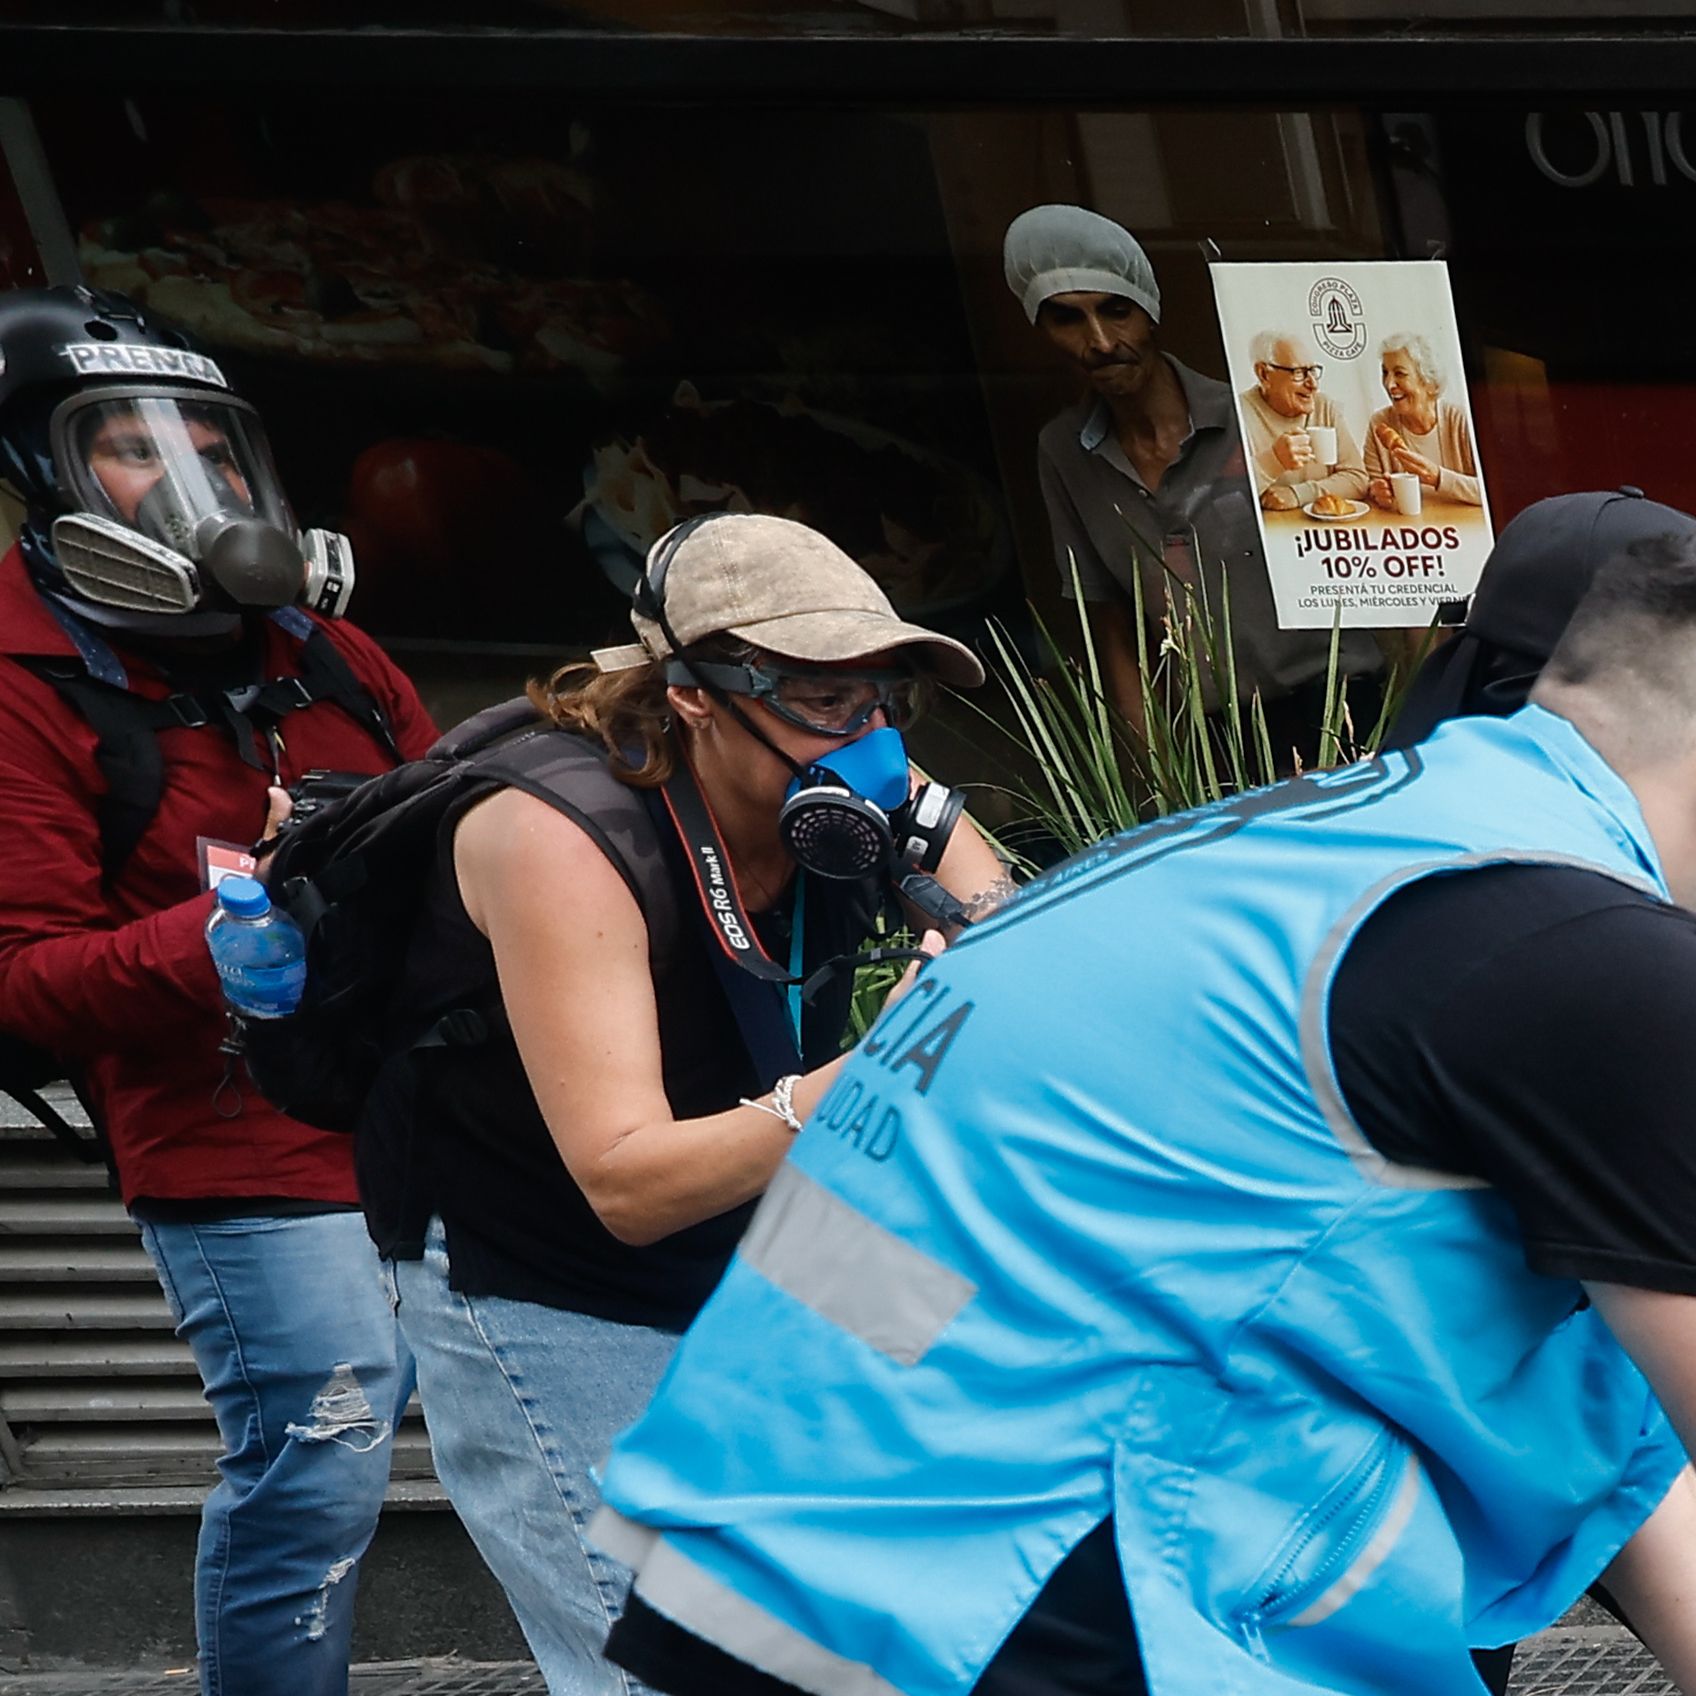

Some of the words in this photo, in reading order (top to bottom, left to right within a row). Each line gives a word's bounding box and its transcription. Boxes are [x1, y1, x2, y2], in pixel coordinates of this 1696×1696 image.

[1295, 527, 1460, 558] ¡JUBILADOS
[1321, 556, 1377, 579] 10%
[1383, 555, 1445, 578] OFF!
[1298, 599, 1318, 608] LOS
[1360, 596, 1419, 607] MIÉRCOLES
[1421, 597, 1427, 606] Y
[1310, 583, 1367, 595] PRESENTÁ
[1370, 584, 1385, 595] TU
[1387, 583, 1458, 595] CREDENCIAL
[705, 855, 725, 885] Mark
[717, 911, 751, 950] EOS
